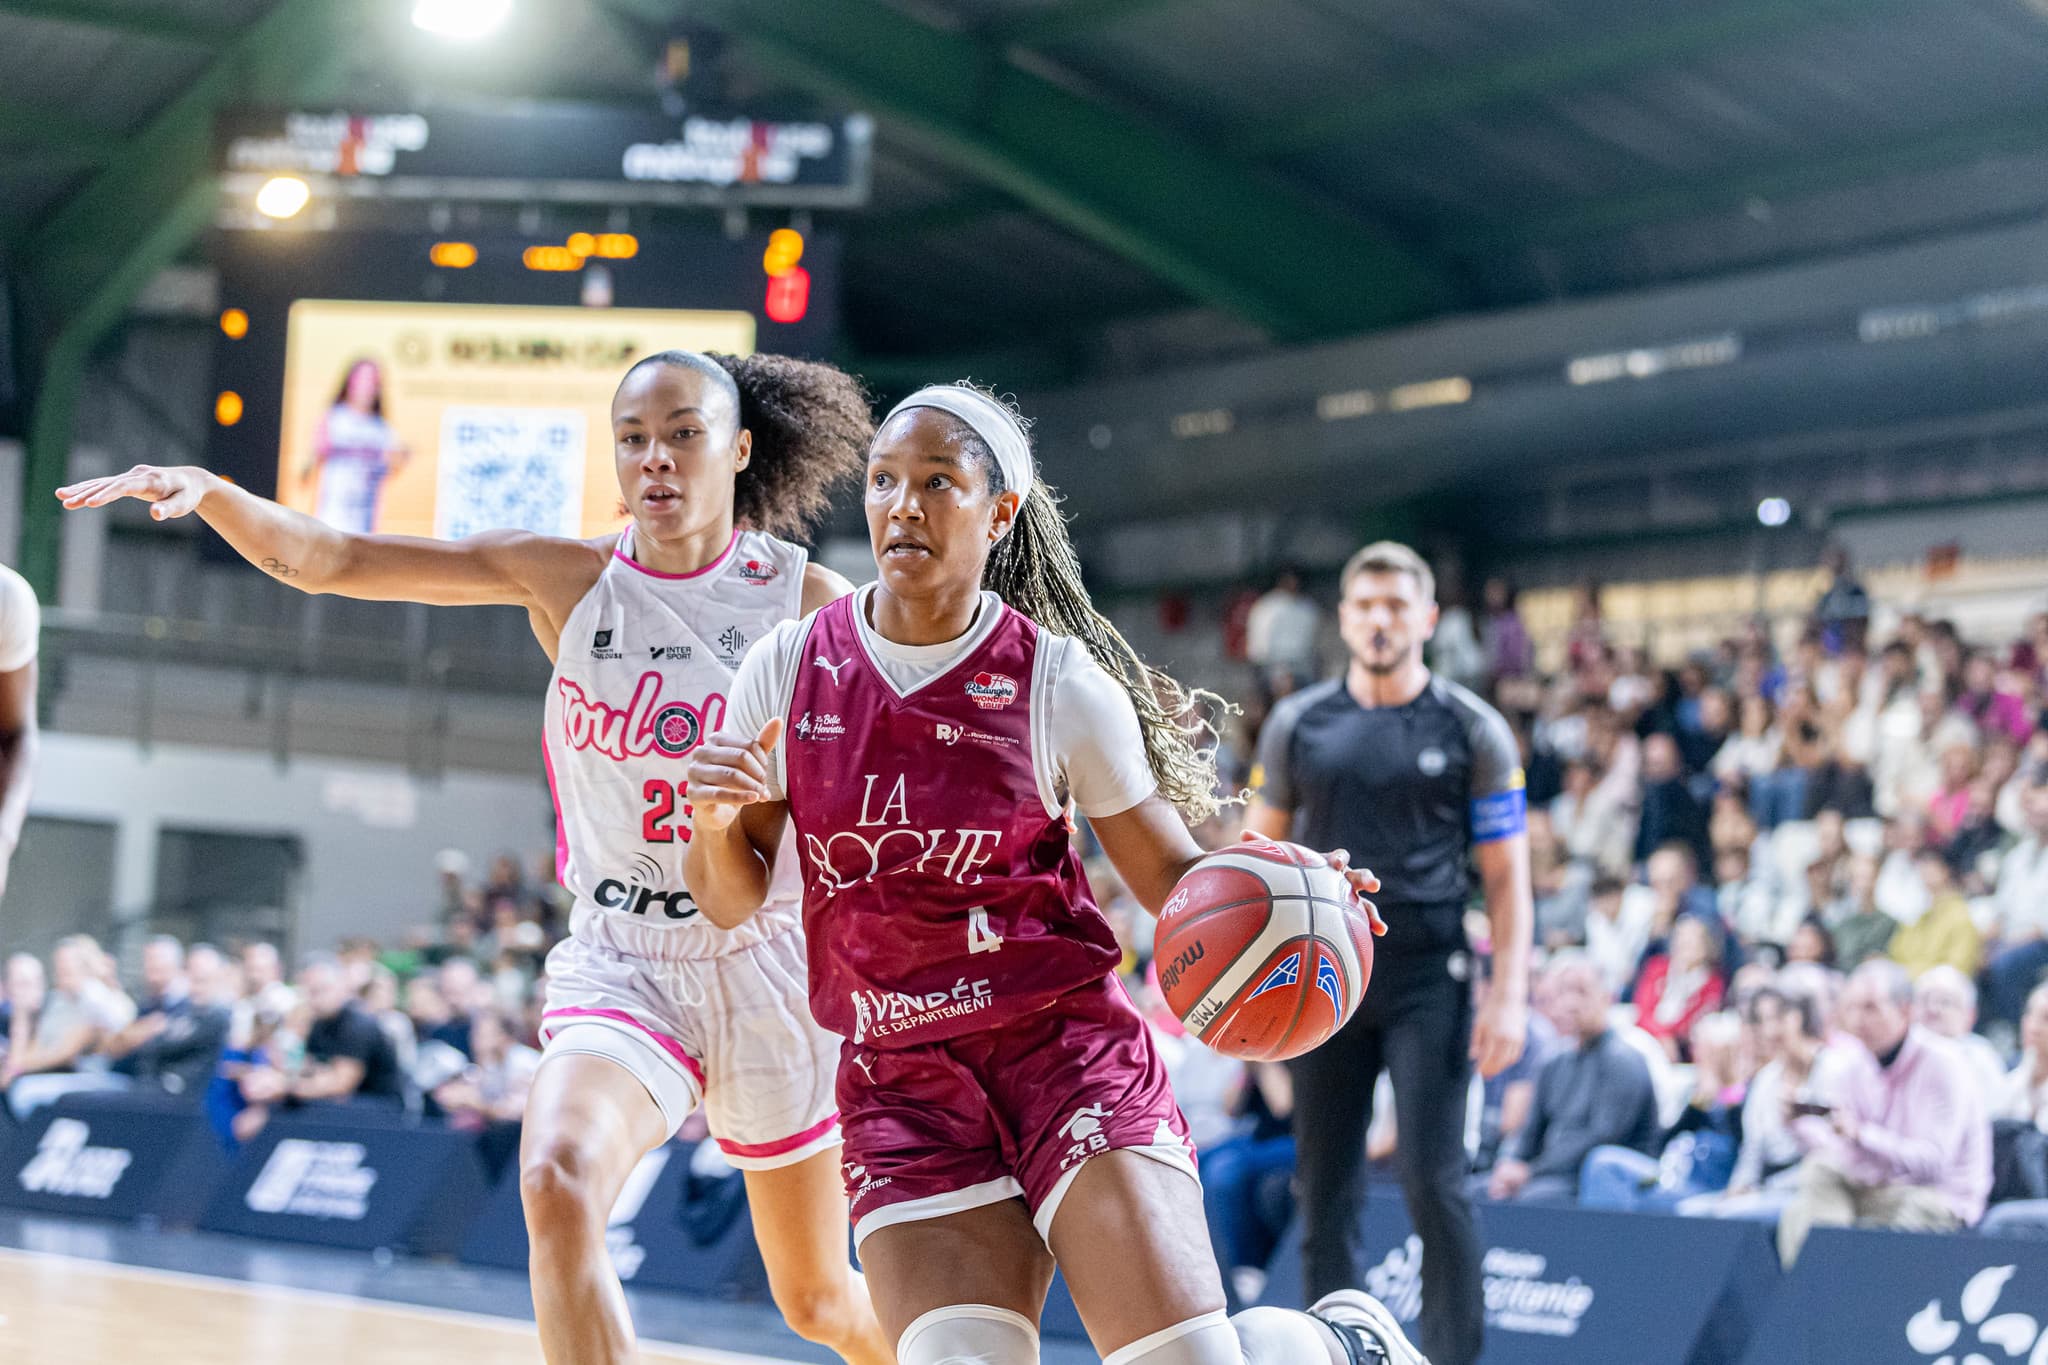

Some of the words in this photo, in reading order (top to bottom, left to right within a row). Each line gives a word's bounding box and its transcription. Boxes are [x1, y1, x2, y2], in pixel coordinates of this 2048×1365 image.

[666, 646, 692, 654] INTER
[971, 694, 1010, 705] WONDER
[856, 772, 911, 827] LA
[967, 905, 1005, 955] 4
[866, 977, 992, 1022] VENDÉE
[872, 1024, 891, 1038] LE
[890, 994, 994, 1033] DÉPARTEMENT
[1191, 997, 1224, 1028] TMB
